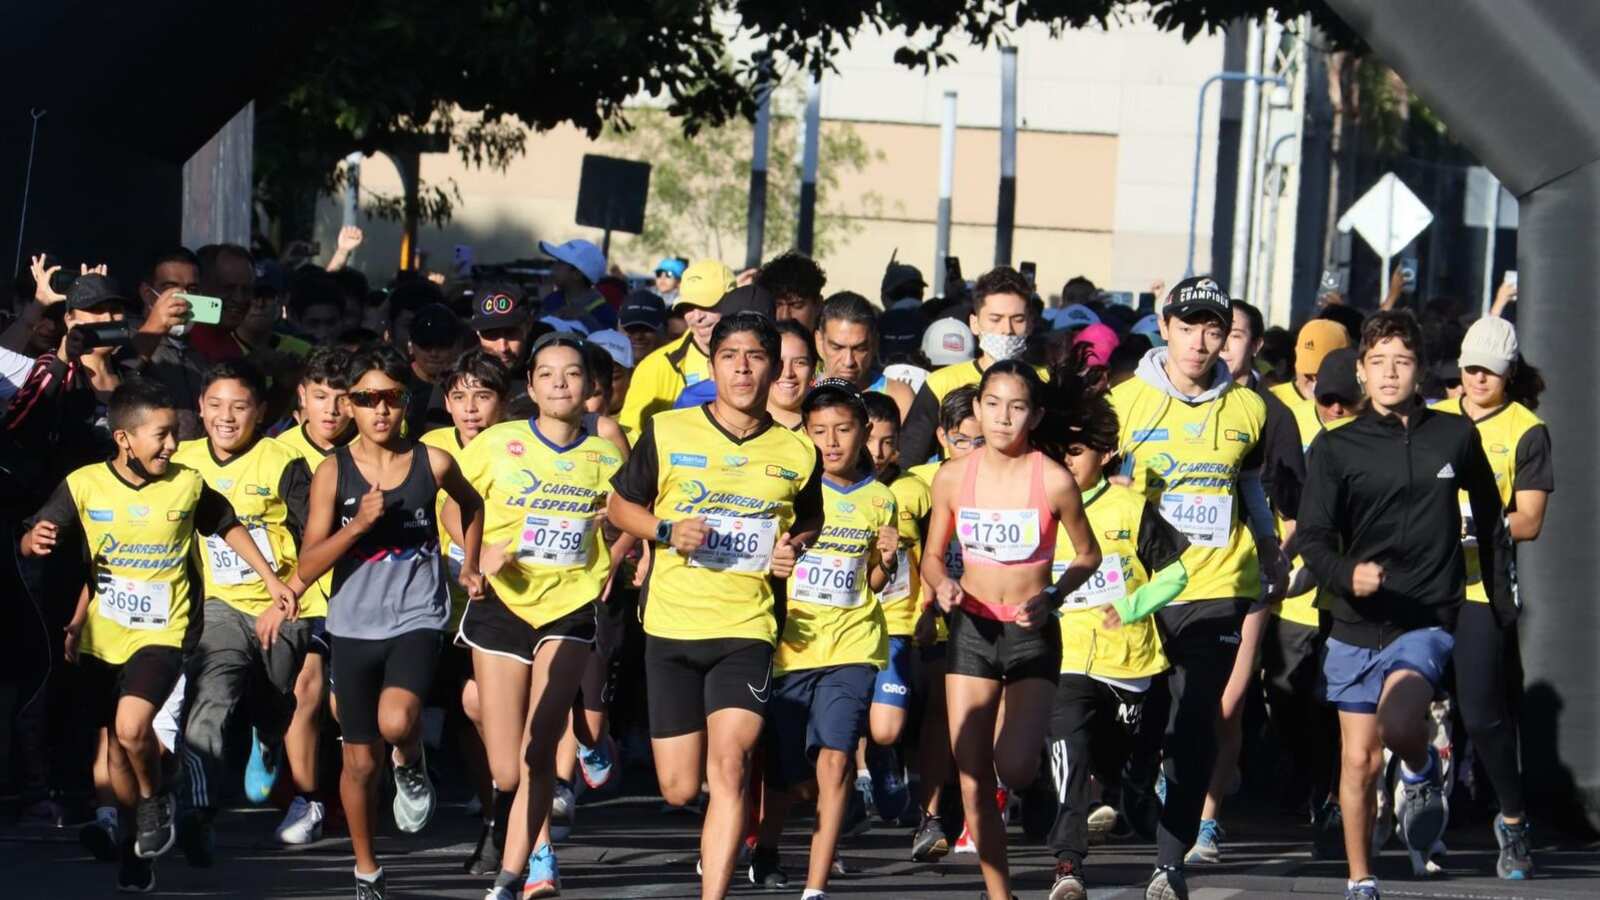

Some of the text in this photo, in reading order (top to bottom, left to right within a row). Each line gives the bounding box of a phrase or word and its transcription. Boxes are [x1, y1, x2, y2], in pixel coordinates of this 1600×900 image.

[1178, 462, 1228, 474] CARRERA
[542, 482, 597, 499] CARRERA
[506, 495, 526, 508] LA
[675, 502, 693, 513] LA
[708, 492, 765, 510] CARRERA
[1172, 503, 1218, 524] 4480
[534, 528, 582, 551] 0759
[707, 530, 759, 553] 0486
[821, 526, 876, 541] CARRERA
[972, 523, 1020, 543] 1730
[119, 543, 169, 555] CARRERA
[213, 550, 241, 569] 367
[808, 566, 855, 590] 0766
[106, 587, 152, 613] 3696
